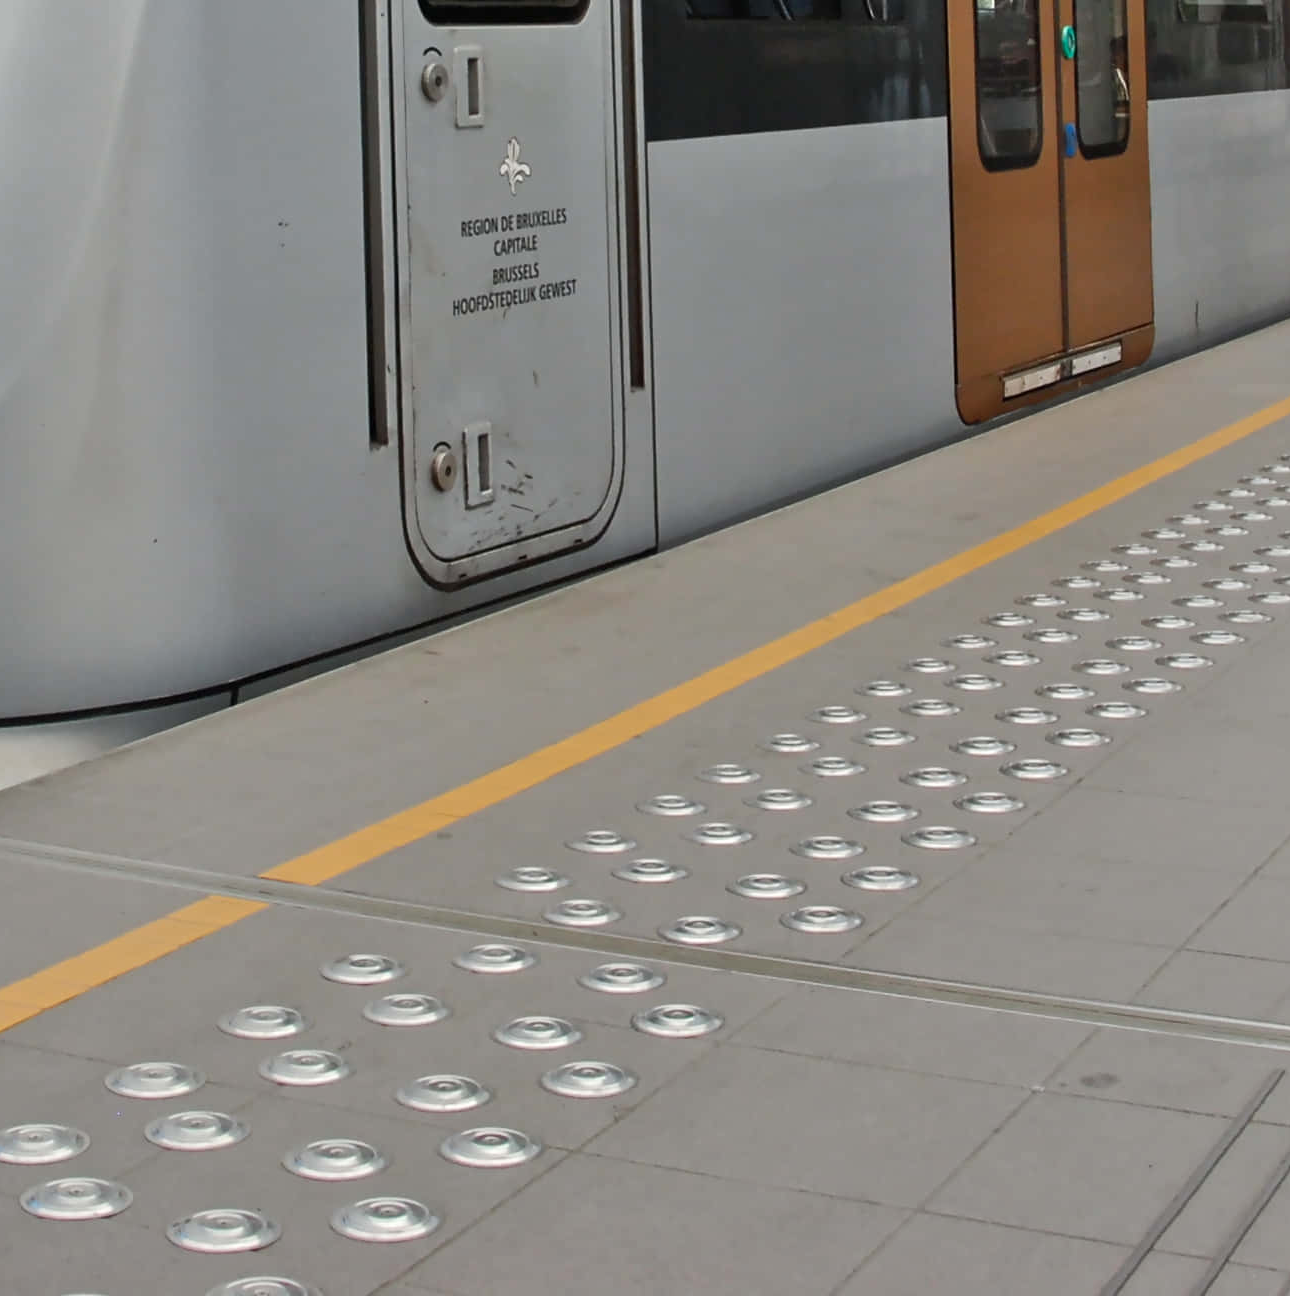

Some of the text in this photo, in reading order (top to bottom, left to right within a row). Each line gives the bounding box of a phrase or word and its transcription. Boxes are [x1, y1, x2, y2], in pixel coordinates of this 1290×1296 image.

[461, 207, 567, 238] REGION DE BRUXELLES
[493, 234, 538, 257] CAPITALE
[492, 262, 540, 285] BRUSSELS
[452, 279, 577, 317] HOOFDSTEDELIJK GEWEST
